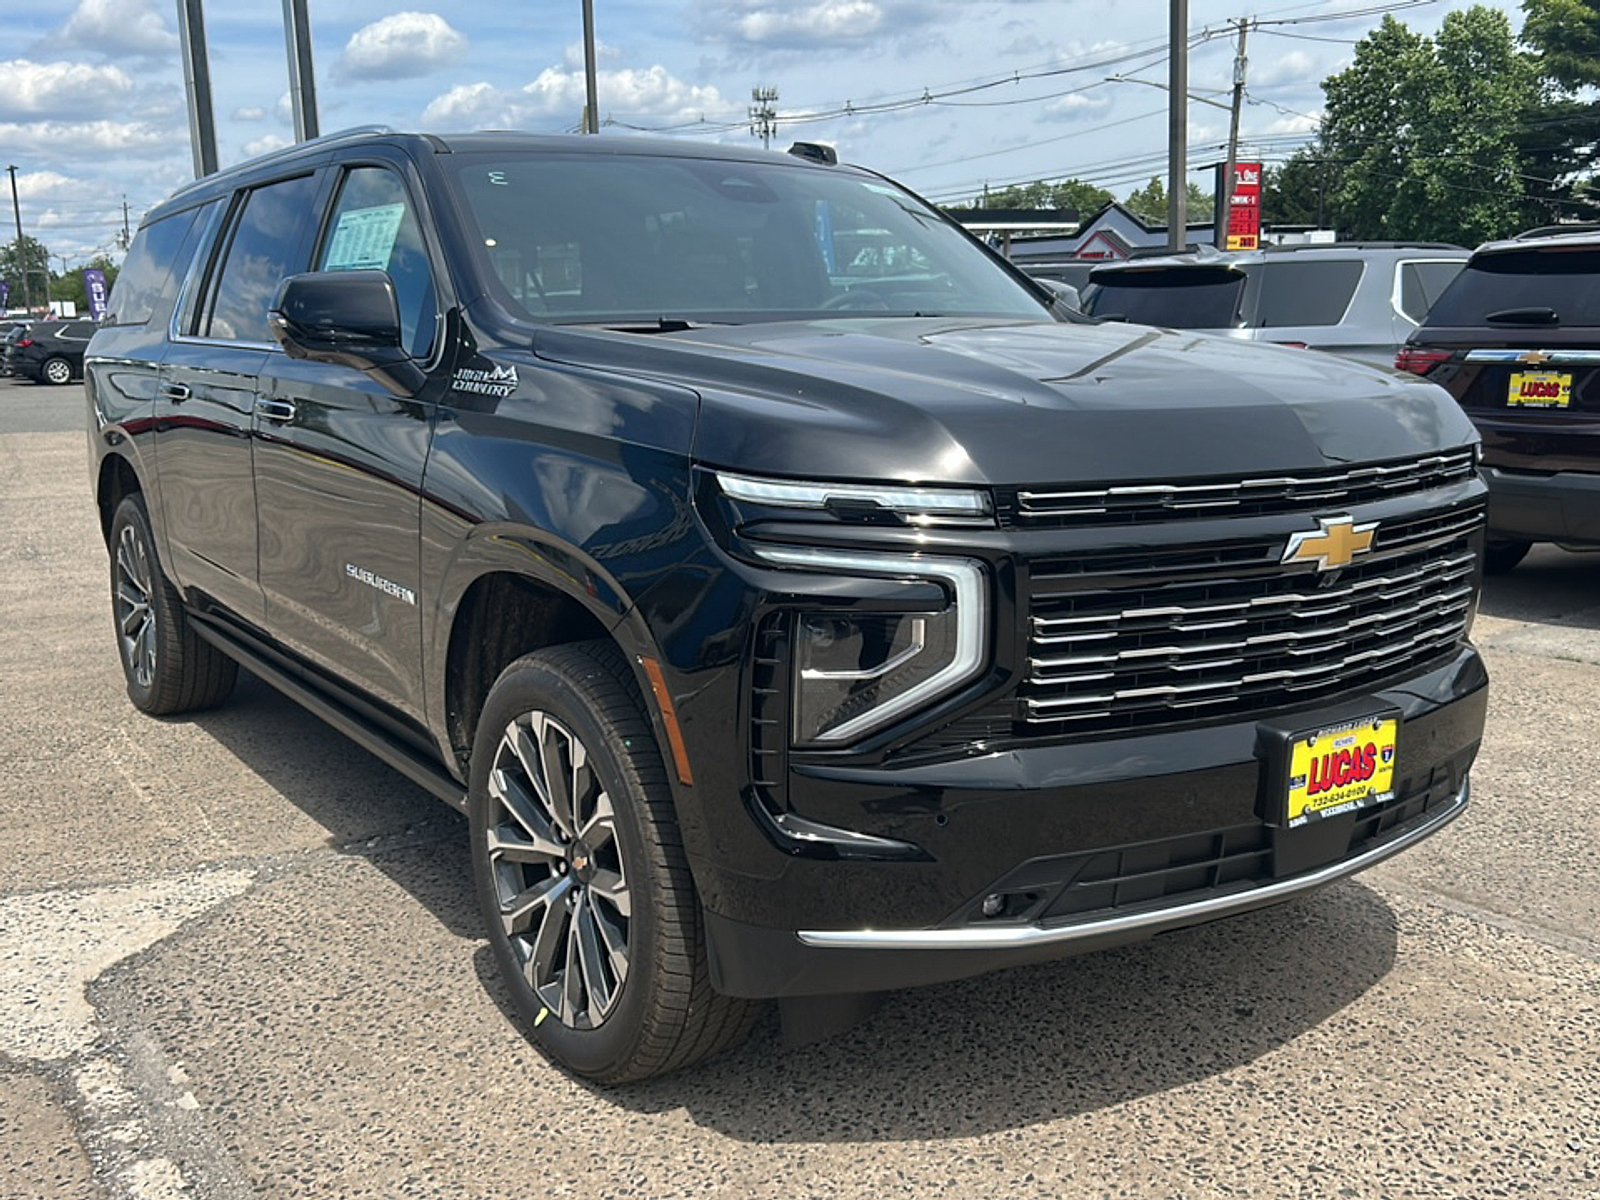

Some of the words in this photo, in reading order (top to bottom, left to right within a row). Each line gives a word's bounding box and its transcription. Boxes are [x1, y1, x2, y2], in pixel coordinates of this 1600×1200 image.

[452, 380, 517, 397] COUNTRY
[1520, 382, 1560, 397] LUCAS
[346, 563, 417, 605] SUBURBAN
[1307, 742, 1377, 795] LUCAS
